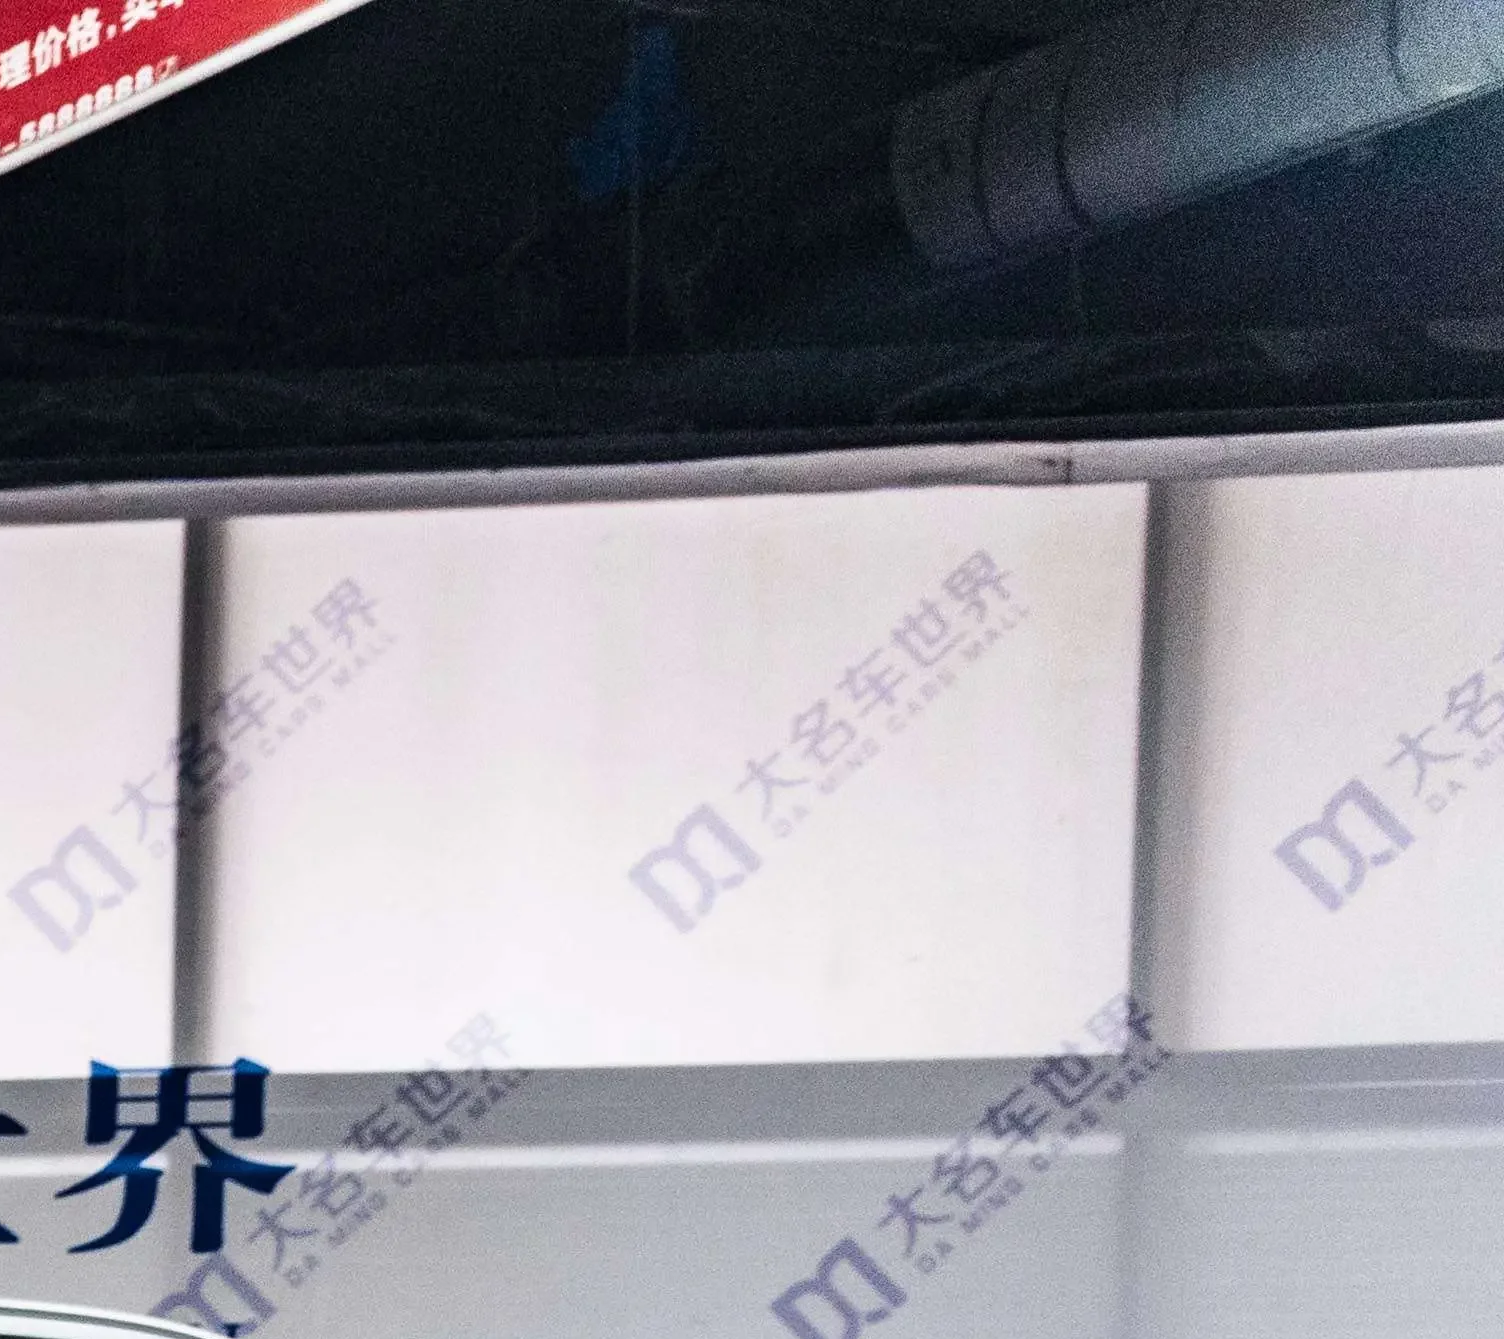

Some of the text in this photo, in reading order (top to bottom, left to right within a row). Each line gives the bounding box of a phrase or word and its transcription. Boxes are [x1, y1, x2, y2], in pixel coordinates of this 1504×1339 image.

[737, 550, 1009, 819] 大名车世界
[1385, 652, 1504, 798] 大名
